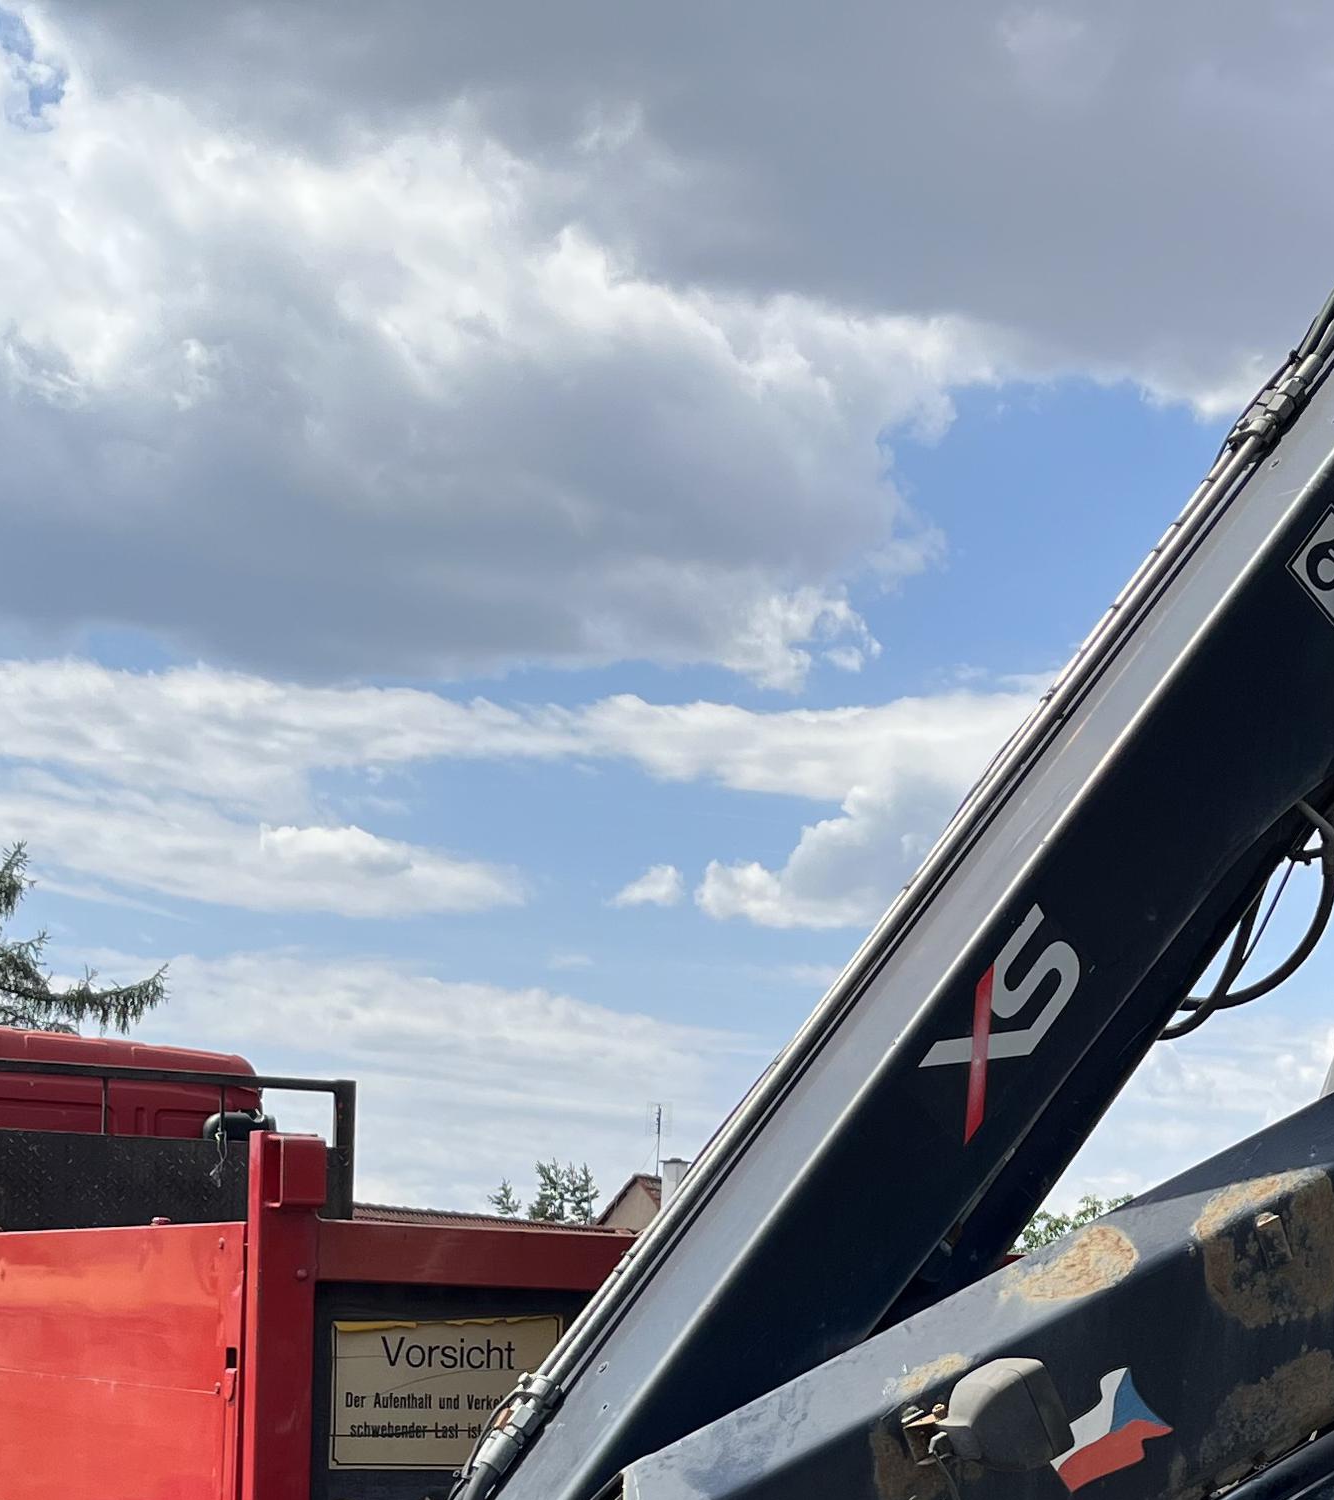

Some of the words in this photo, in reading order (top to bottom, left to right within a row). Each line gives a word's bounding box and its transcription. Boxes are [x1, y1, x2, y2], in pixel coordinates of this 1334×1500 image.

[918, 902, 1081, 1146] XS
[380, 1335, 516, 1370] Vorsicht
[345, 1392, 366, 1408] Der
[373, 1392, 432, 1409] Aufenthalt
[438, 1394, 460, 1410] und
[350, 1421, 427, 1439] schwebender
[434, 1422, 459, 1439] Last
[467, 1422, 482, 1439] ist
